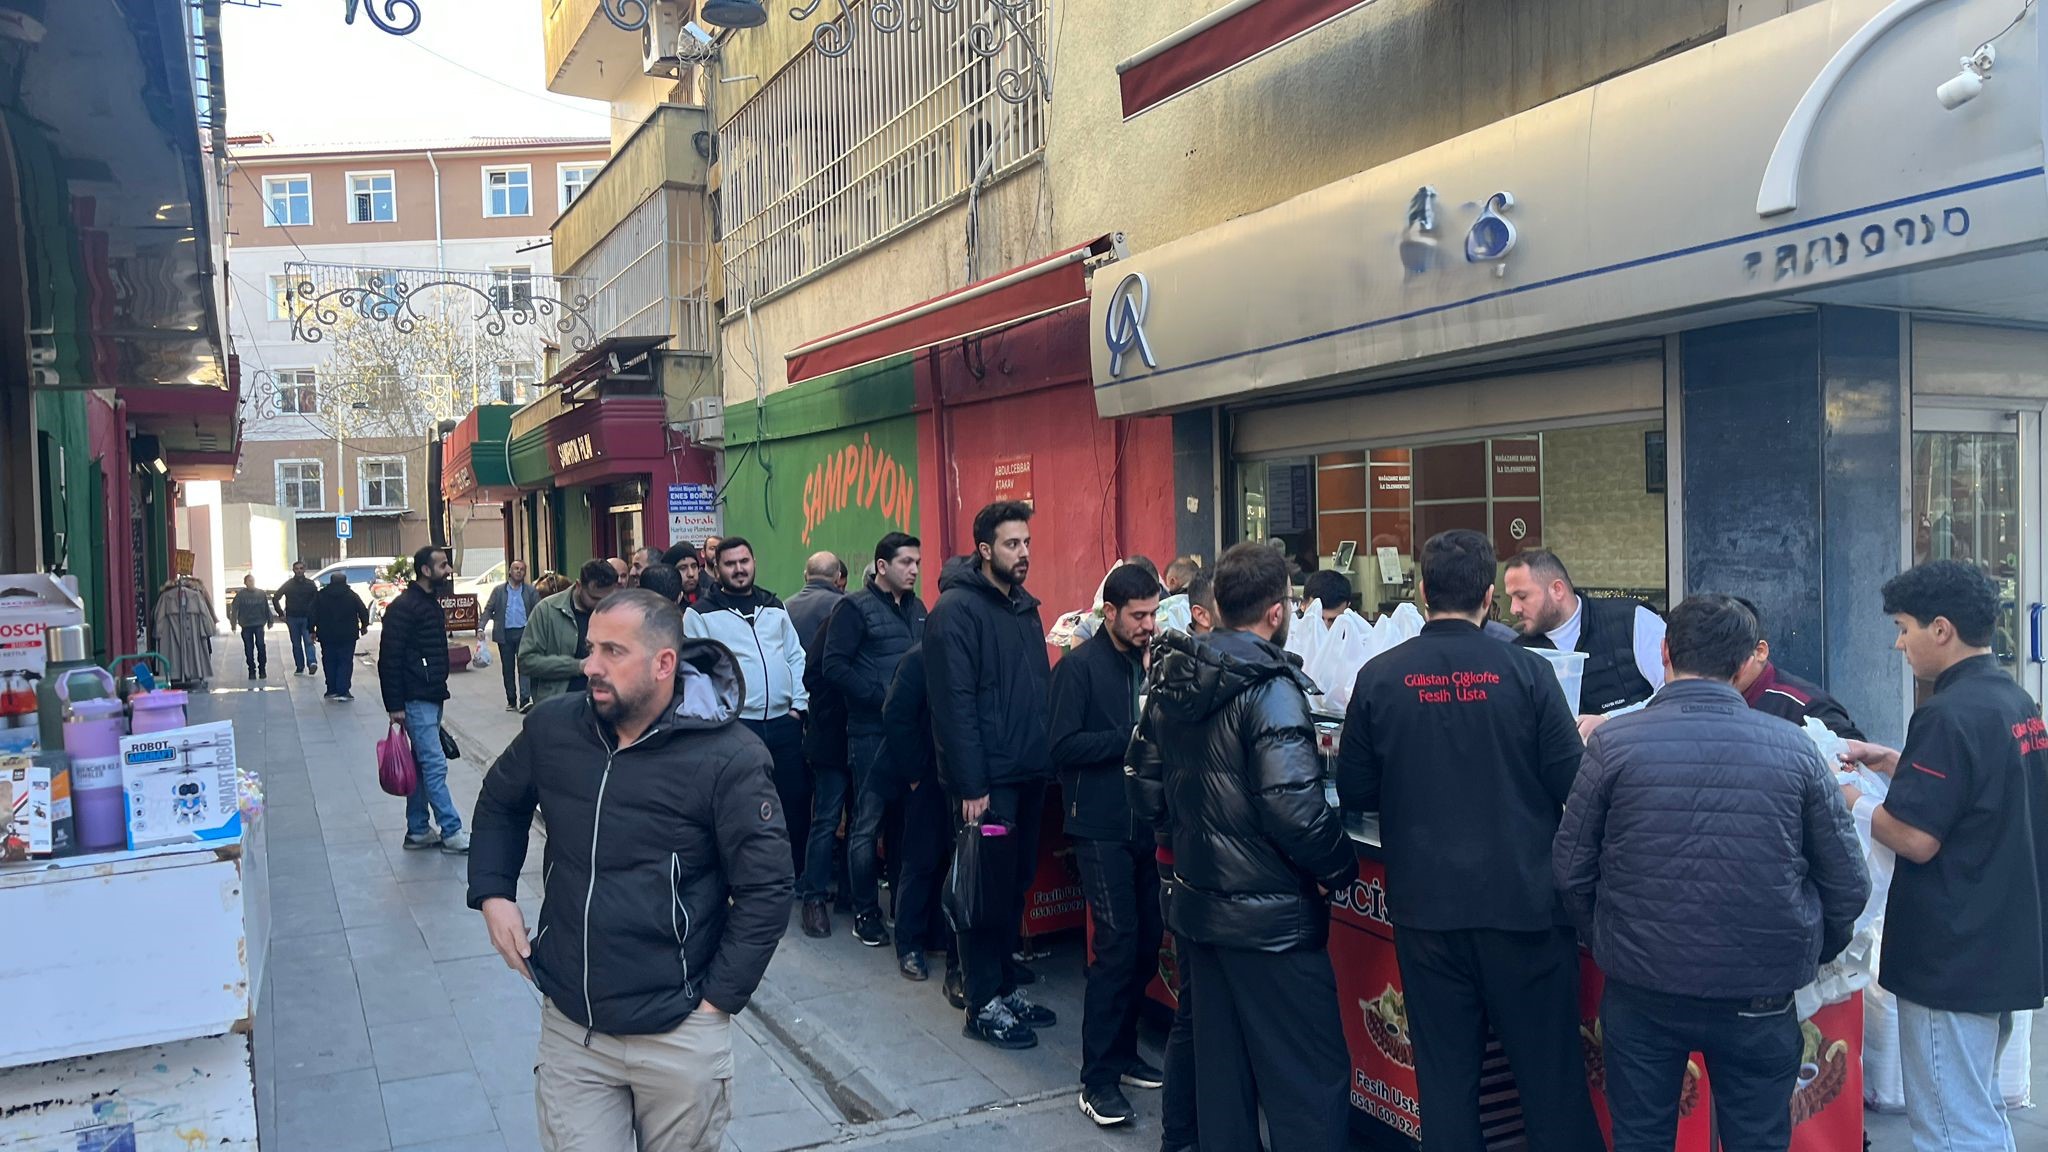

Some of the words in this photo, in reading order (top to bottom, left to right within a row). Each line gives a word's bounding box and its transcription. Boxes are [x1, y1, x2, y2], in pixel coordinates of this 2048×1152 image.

[995, 462, 1031, 476] ABDULCEBBAR
[801, 432, 914, 548] ŞAMPİYON
[341, 521, 348, 533] D
[1404, 673, 1449, 687] Gülistan
[1419, 689, 1451, 703] Fesih
[1456, 687, 1487, 701] Usta
[131, 740, 169, 753] ROBOT
[214, 732, 235, 771] ROBOT
[218, 773, 238, 815] SMART
[1355, 1068, 1391, 1103] Fesih
[1350, 1089, 1376, 1117] 0541
[1377, 1105, 1398, 1129] 609
[1398, 1115, 1414, 1137] 92
